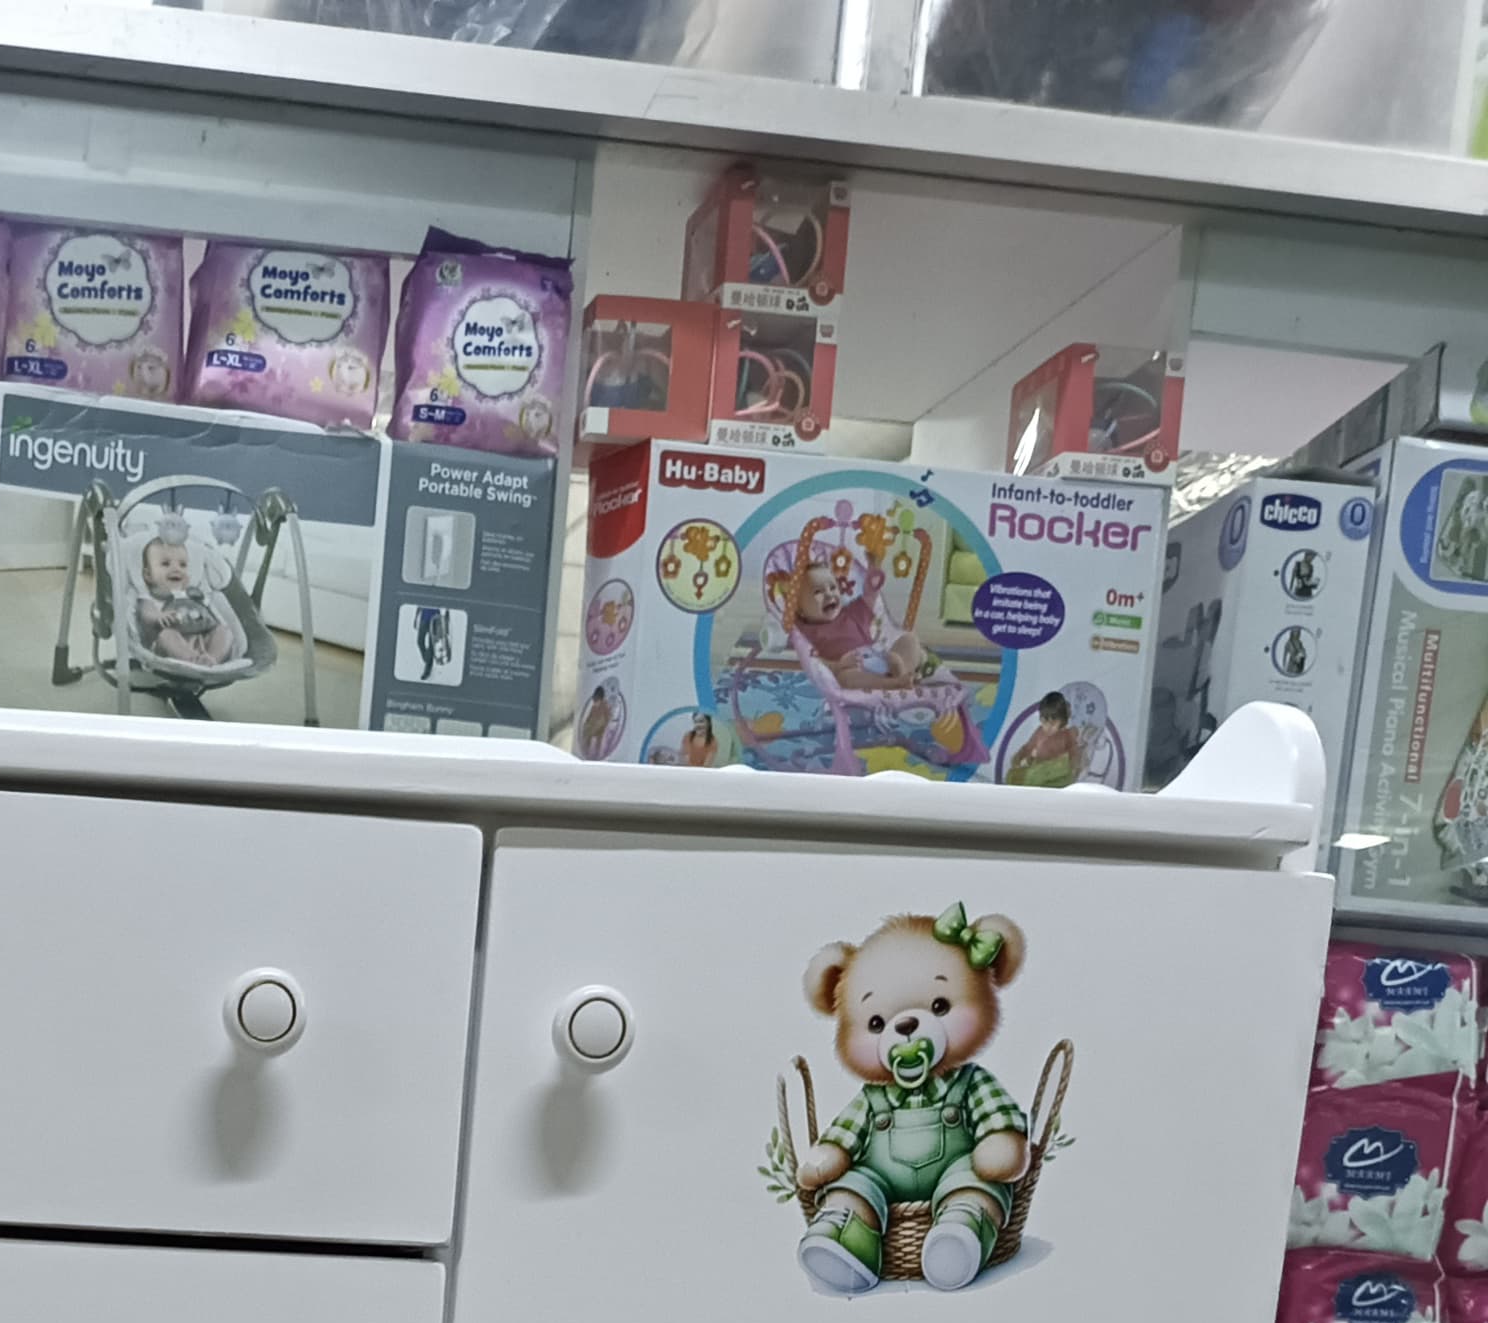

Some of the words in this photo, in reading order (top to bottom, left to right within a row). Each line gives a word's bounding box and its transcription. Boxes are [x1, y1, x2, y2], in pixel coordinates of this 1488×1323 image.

[57, 260, 106, 282] Moyo
[261, 265, 310, 286] Moyo
[56, 279, 144, 301] Comforts
[259, 284, 346, 306] Comforts
[225, 332, 236, 346] 6
[464, 321, 504, 342] Moyo
[462, 341, 533, 358] Comforts
[429, 387, 439, 402] 6
[9, 432, 145, 483] ingenuity
[430, 462, 479, 482] Power
[482, 470, 529, 490] Adapt
[418, 477, 483, 500] Portable
[991, 482, 1135, 512] Infant-to-toddler
[1264, 498, 1318, 525] chicco
[987, 501, 1152, 552] Rocker
[1392, 609, 1418, 690] Musical
[1406, 634, 1440, 780] Multifunctional
[1382, 697, 1406, 757] Piano
